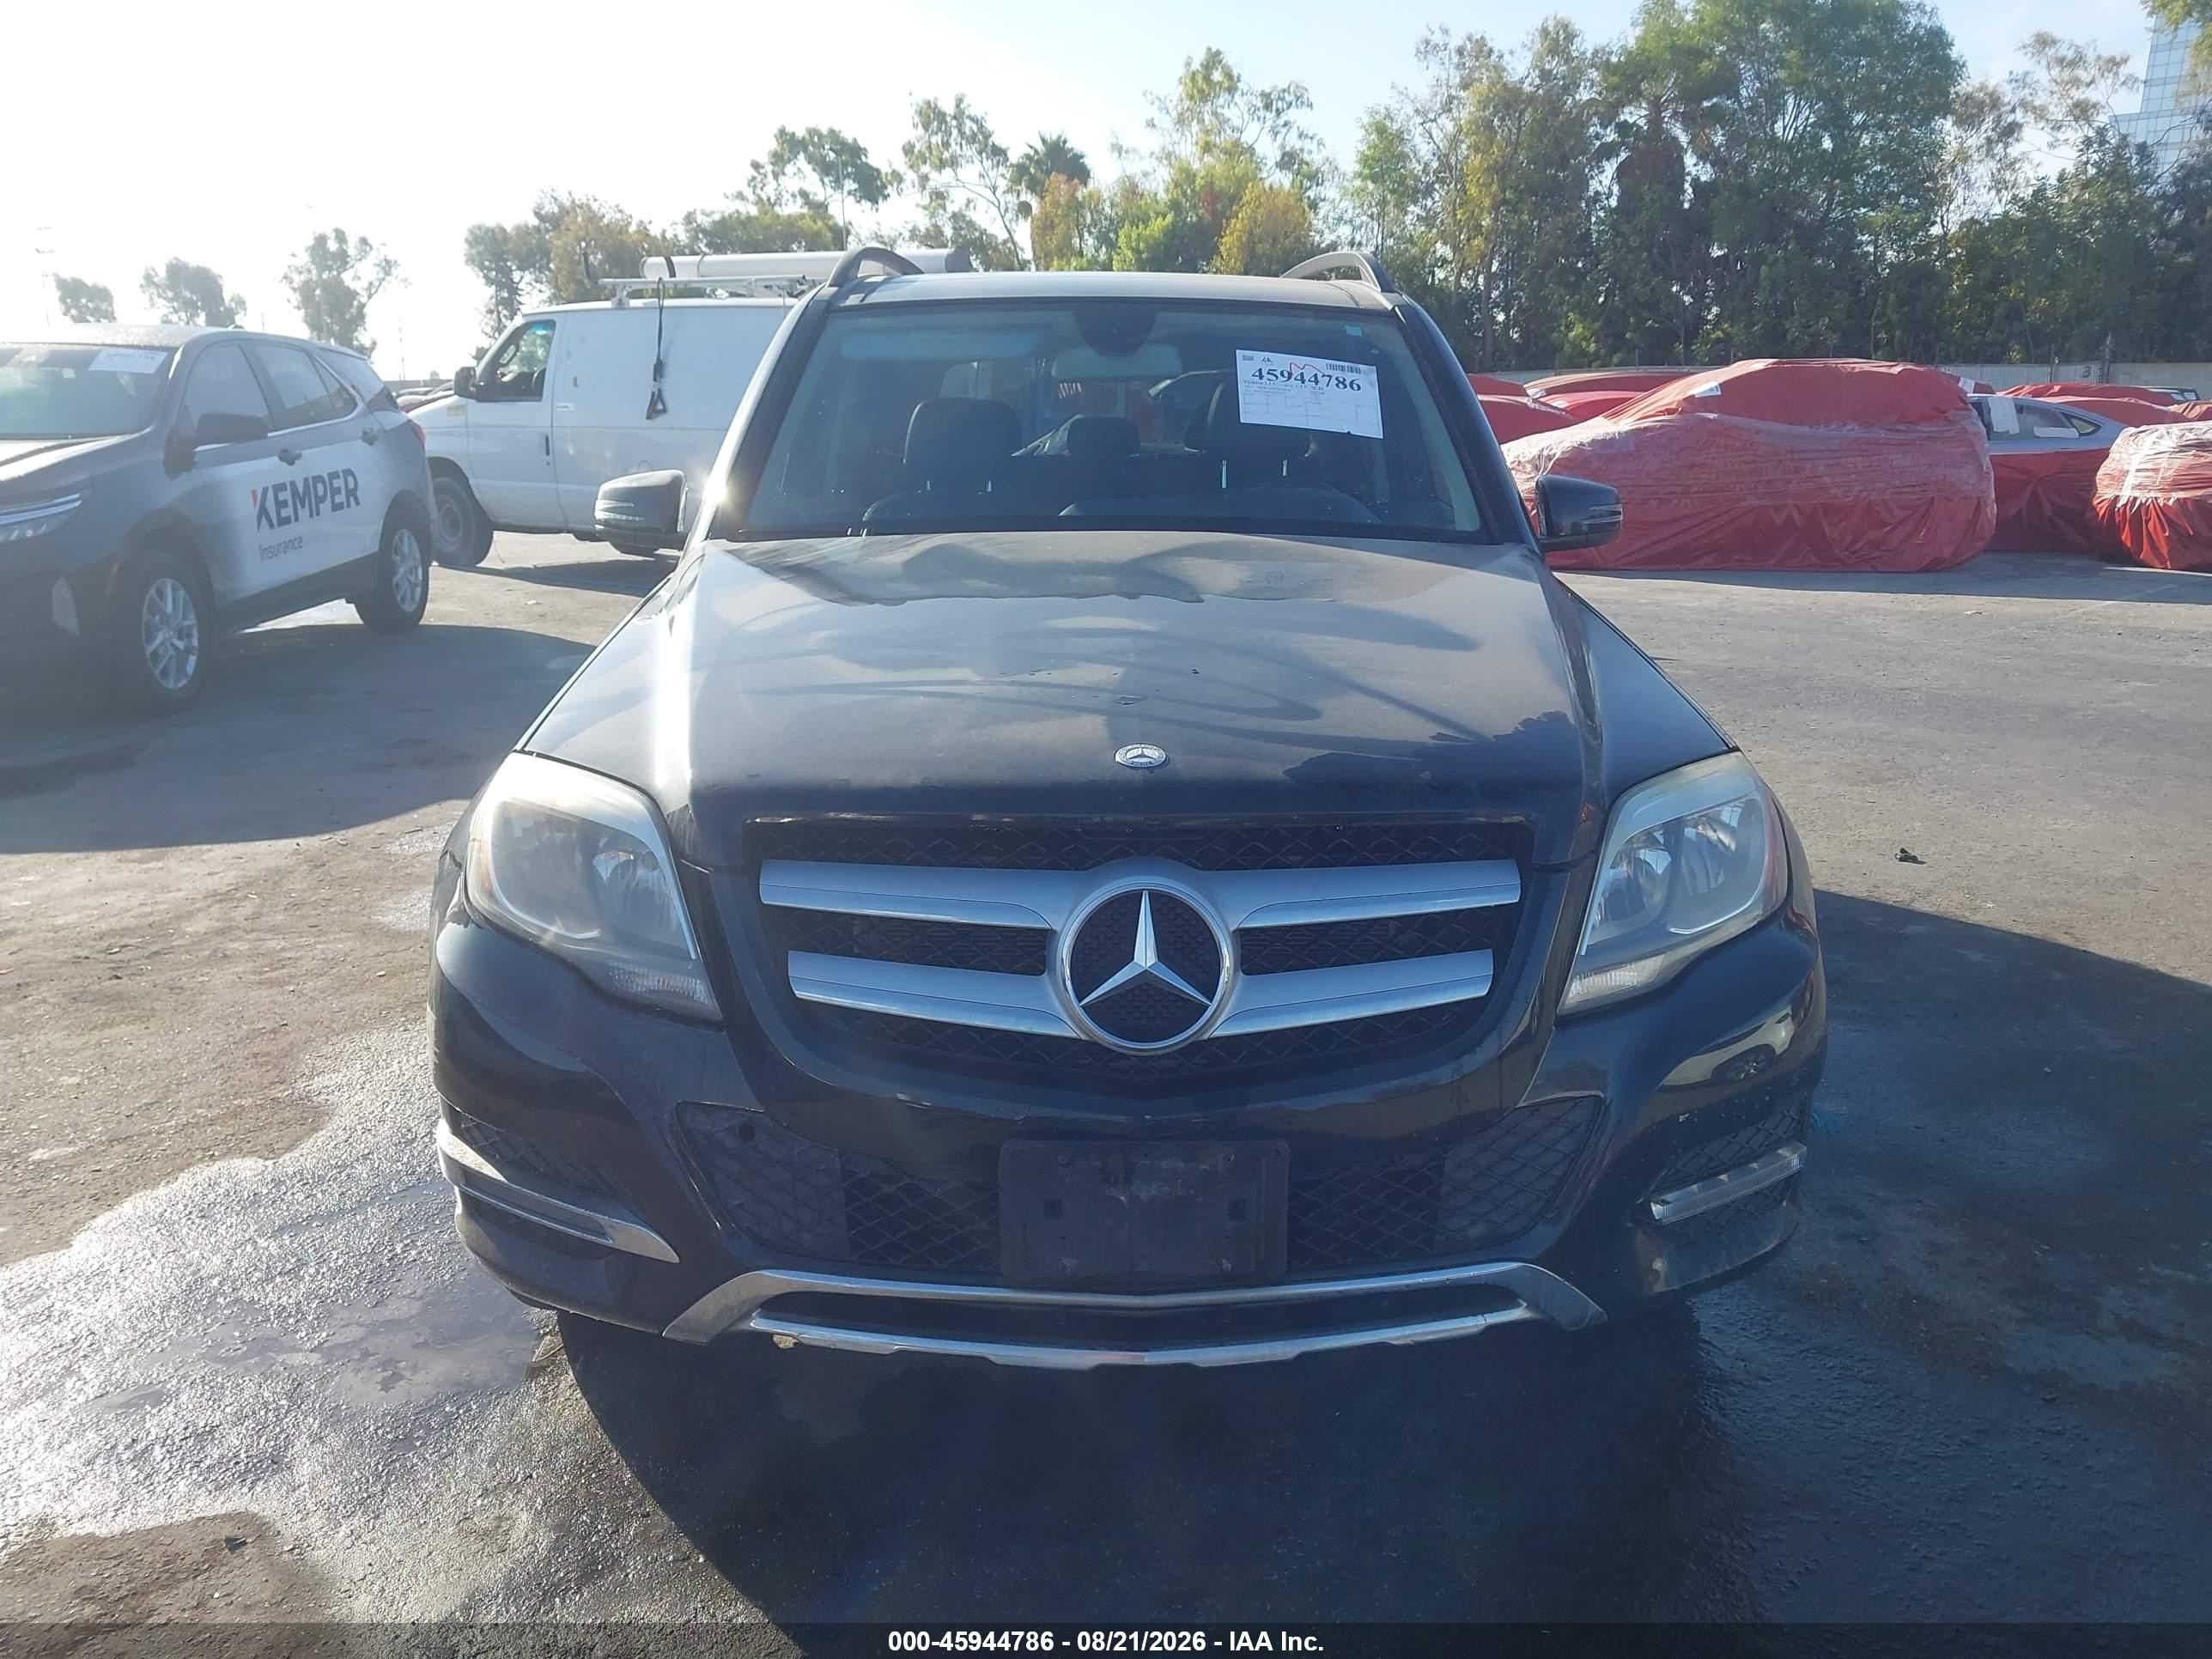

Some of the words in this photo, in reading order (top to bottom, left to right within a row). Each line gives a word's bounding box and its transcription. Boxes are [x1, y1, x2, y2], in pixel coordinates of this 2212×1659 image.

[1251, 367, 1362, 392] 45944786
[251, 468, 361, 532] KEMPER
[259, 536, 303, 562] Insurance
